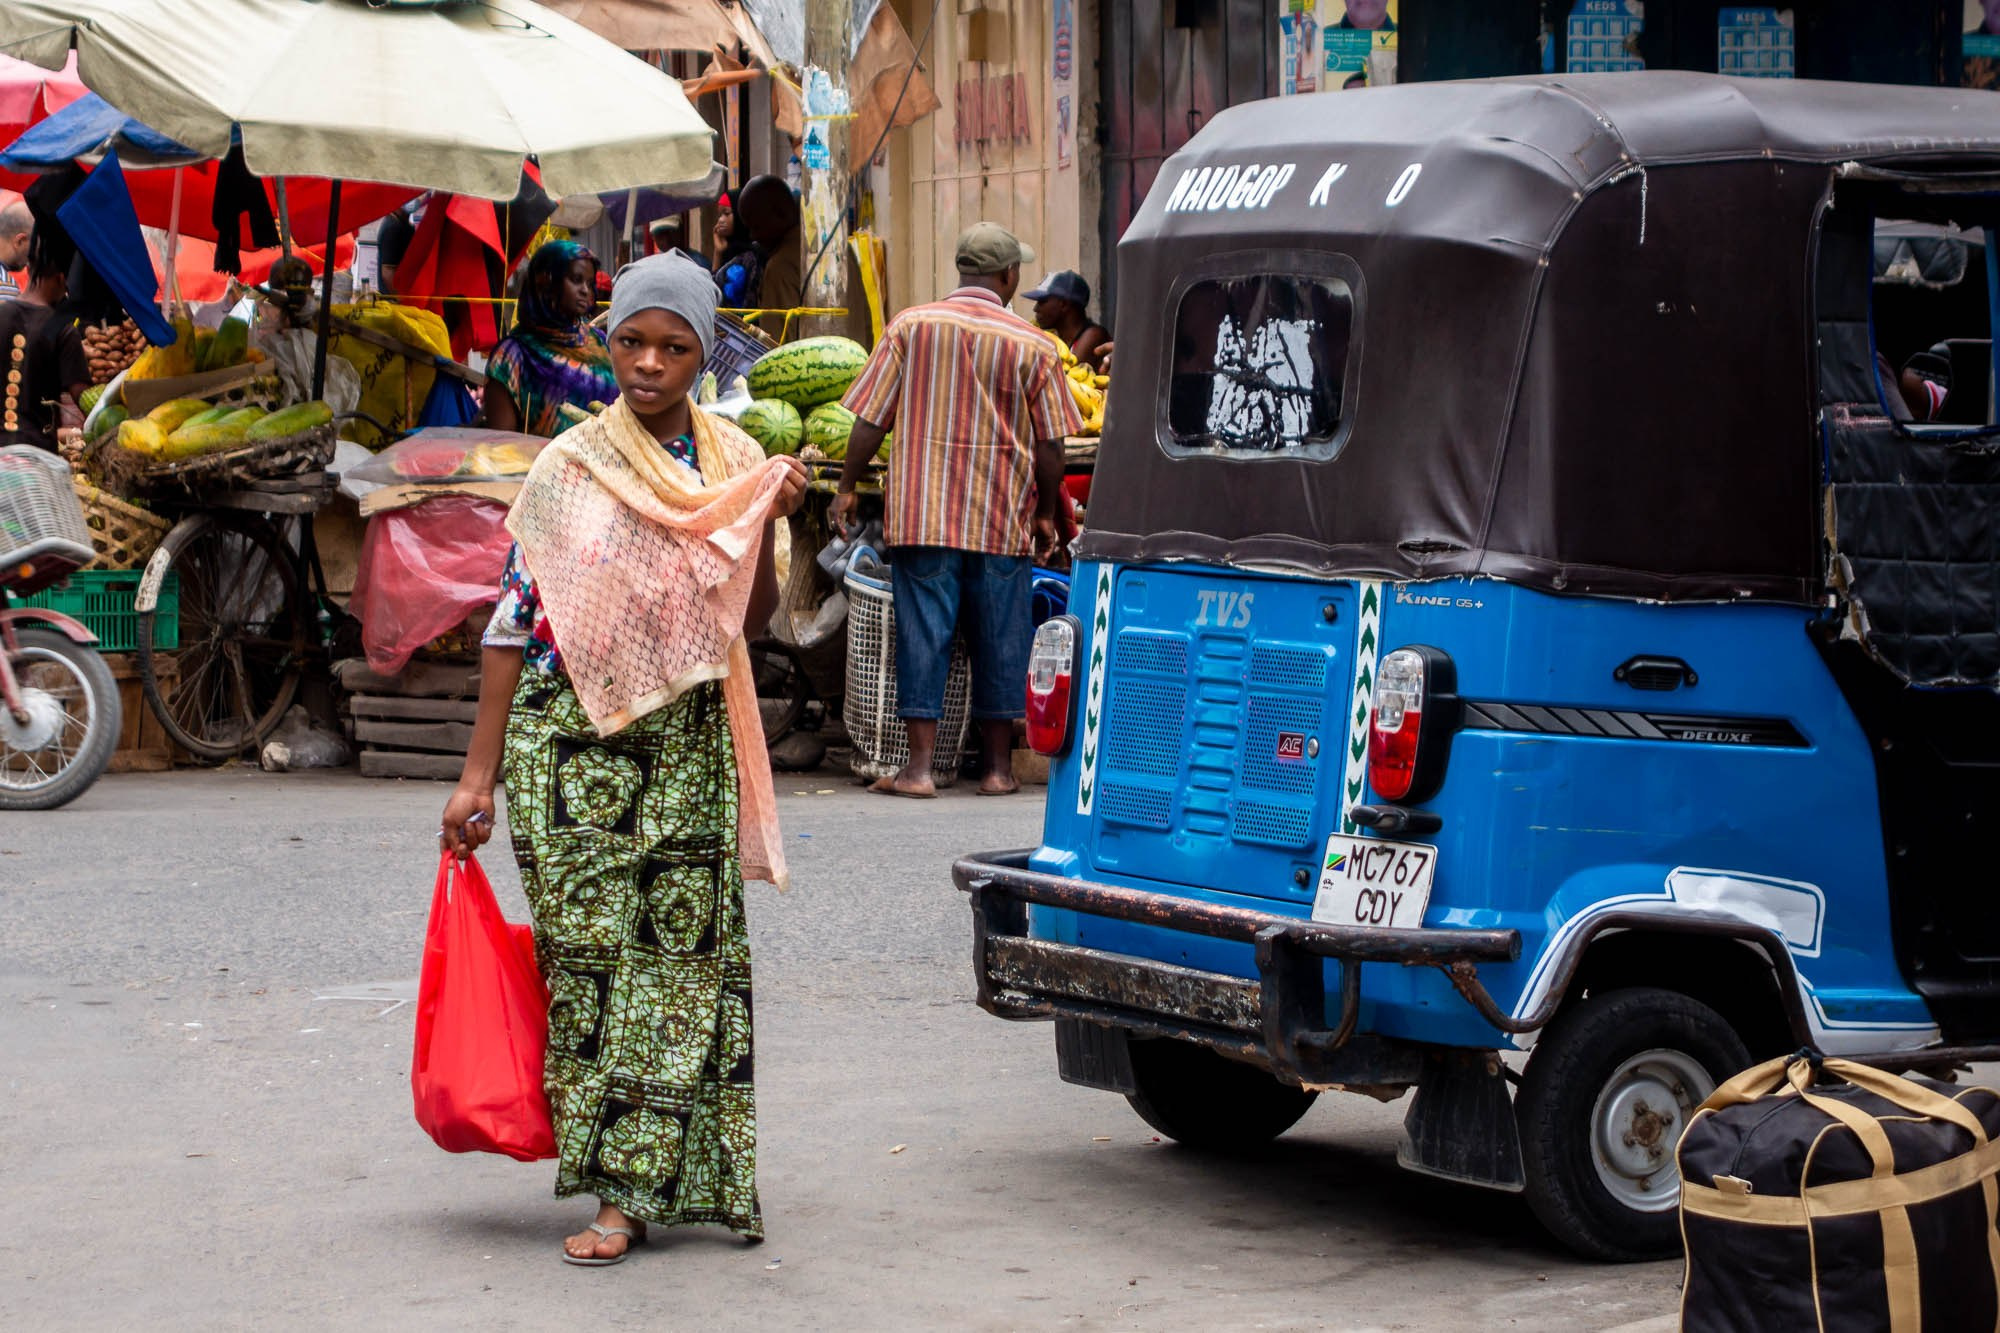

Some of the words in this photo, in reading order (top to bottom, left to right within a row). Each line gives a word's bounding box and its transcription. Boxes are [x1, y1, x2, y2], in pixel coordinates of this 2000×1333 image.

[1310, 163, 1348, 207] K
[1392, 583, 1407, 592] TVS
[1396, 592, 1451, 607] KING
[1195, 589, 1255, 628] TVS
[1681, 730, 1753, 744] DELUXE
[1347, 844, 1429, 888] MC767
[1355, 888, 1404, 927] CDY
